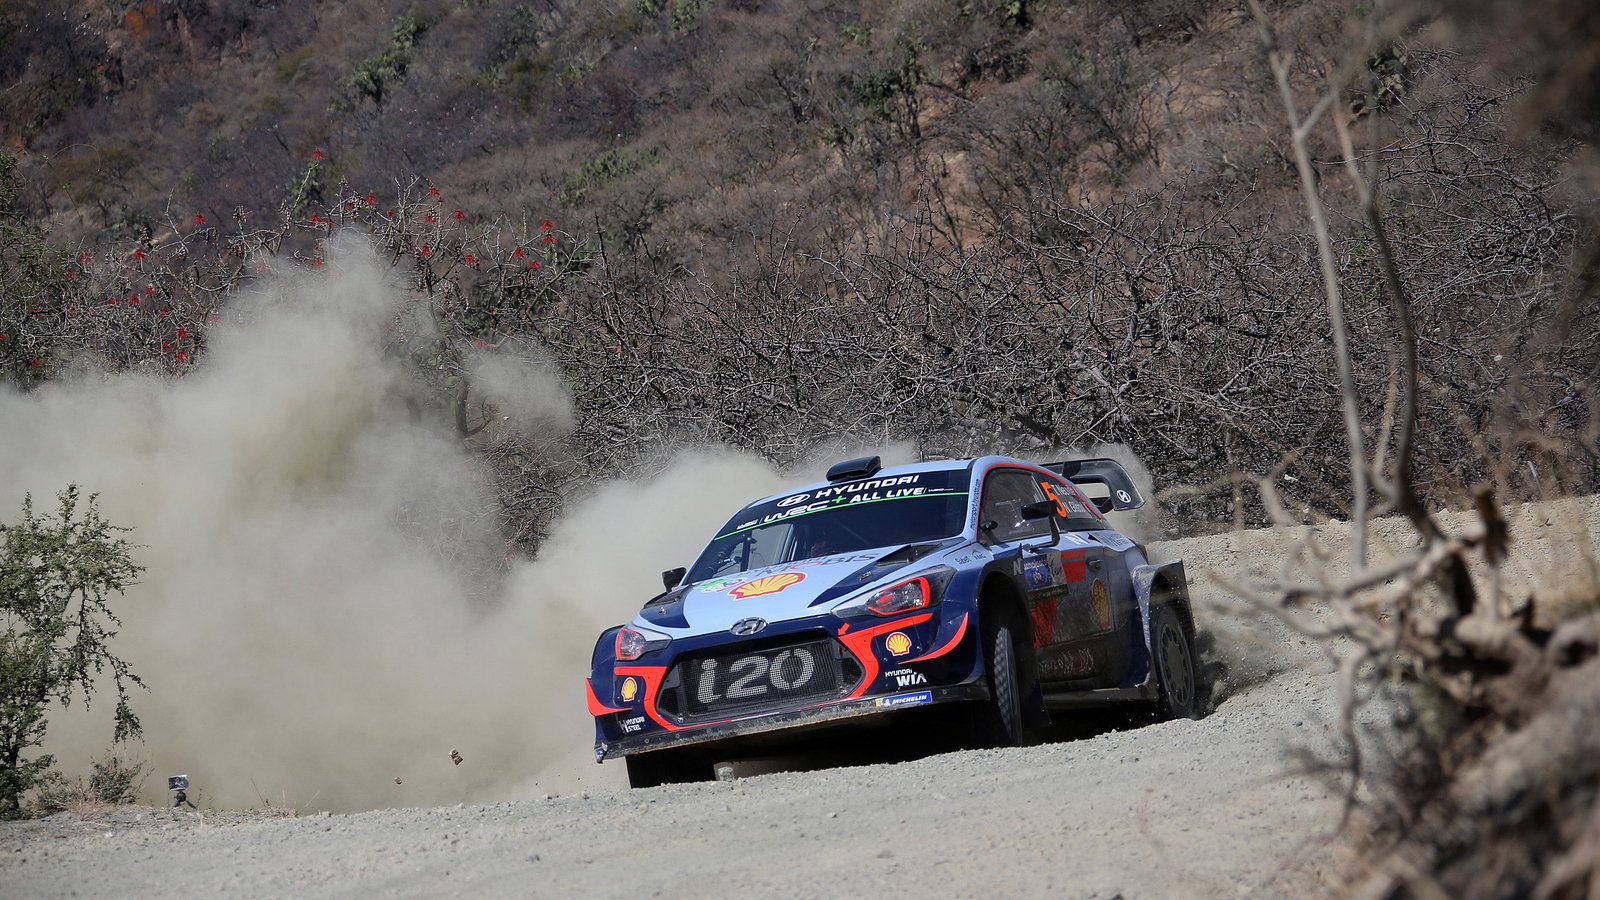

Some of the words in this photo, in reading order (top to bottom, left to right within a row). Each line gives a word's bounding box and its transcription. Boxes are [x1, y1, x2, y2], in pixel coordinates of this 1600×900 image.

[815, 475, 919, 499] HYUNDAI
[849, 493, 881, 504] ALL
[886, 487, 924, 499] LIVE
[1041, 482, 1068, 518] 5
[698, 647, 814, 704] i20
[885, 668, 913, 677] HYUNDAI
[892, 695, 928, 705] MICHELIN
[626, 716, 645, 725] HYUNDAI
[628, 724, 642, 732] STEEL
